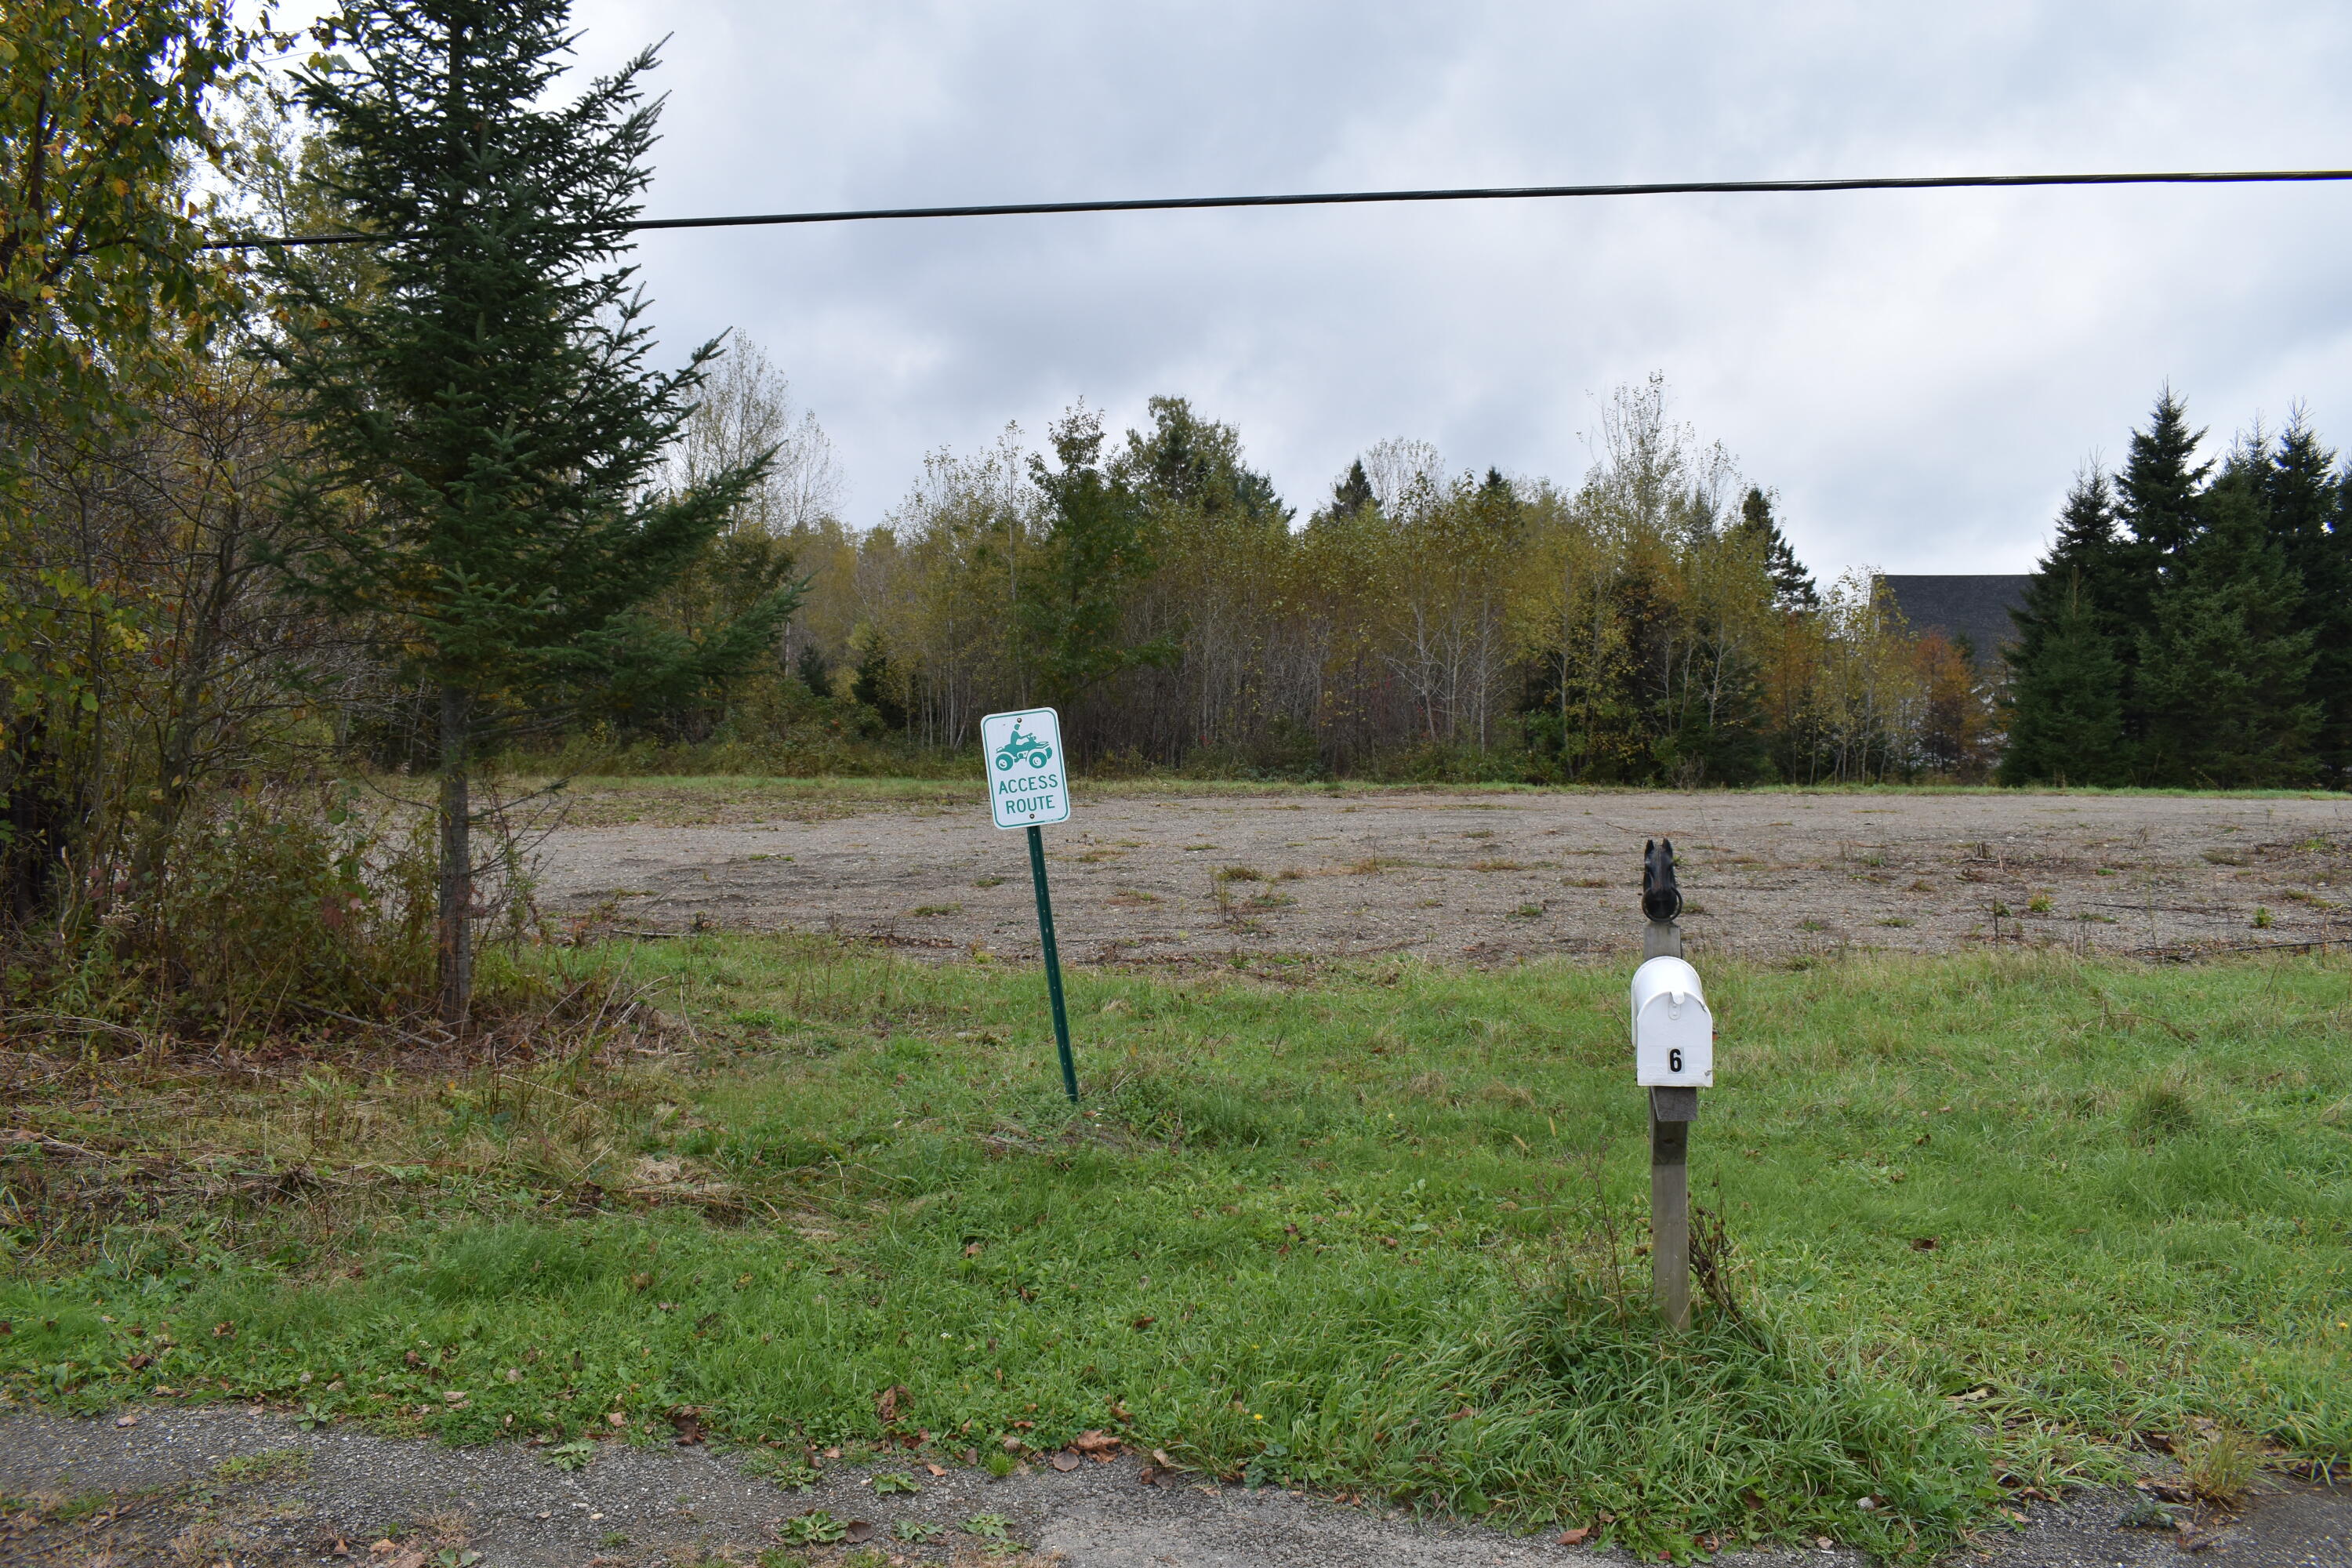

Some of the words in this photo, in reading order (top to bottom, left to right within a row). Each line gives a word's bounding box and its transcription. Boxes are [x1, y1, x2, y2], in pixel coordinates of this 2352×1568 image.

[999, 774, 1058, 794] ACCESS
[1005, 795, 1055, 814] ROUTE
[1669, 1048, 1682, 1073] 6
